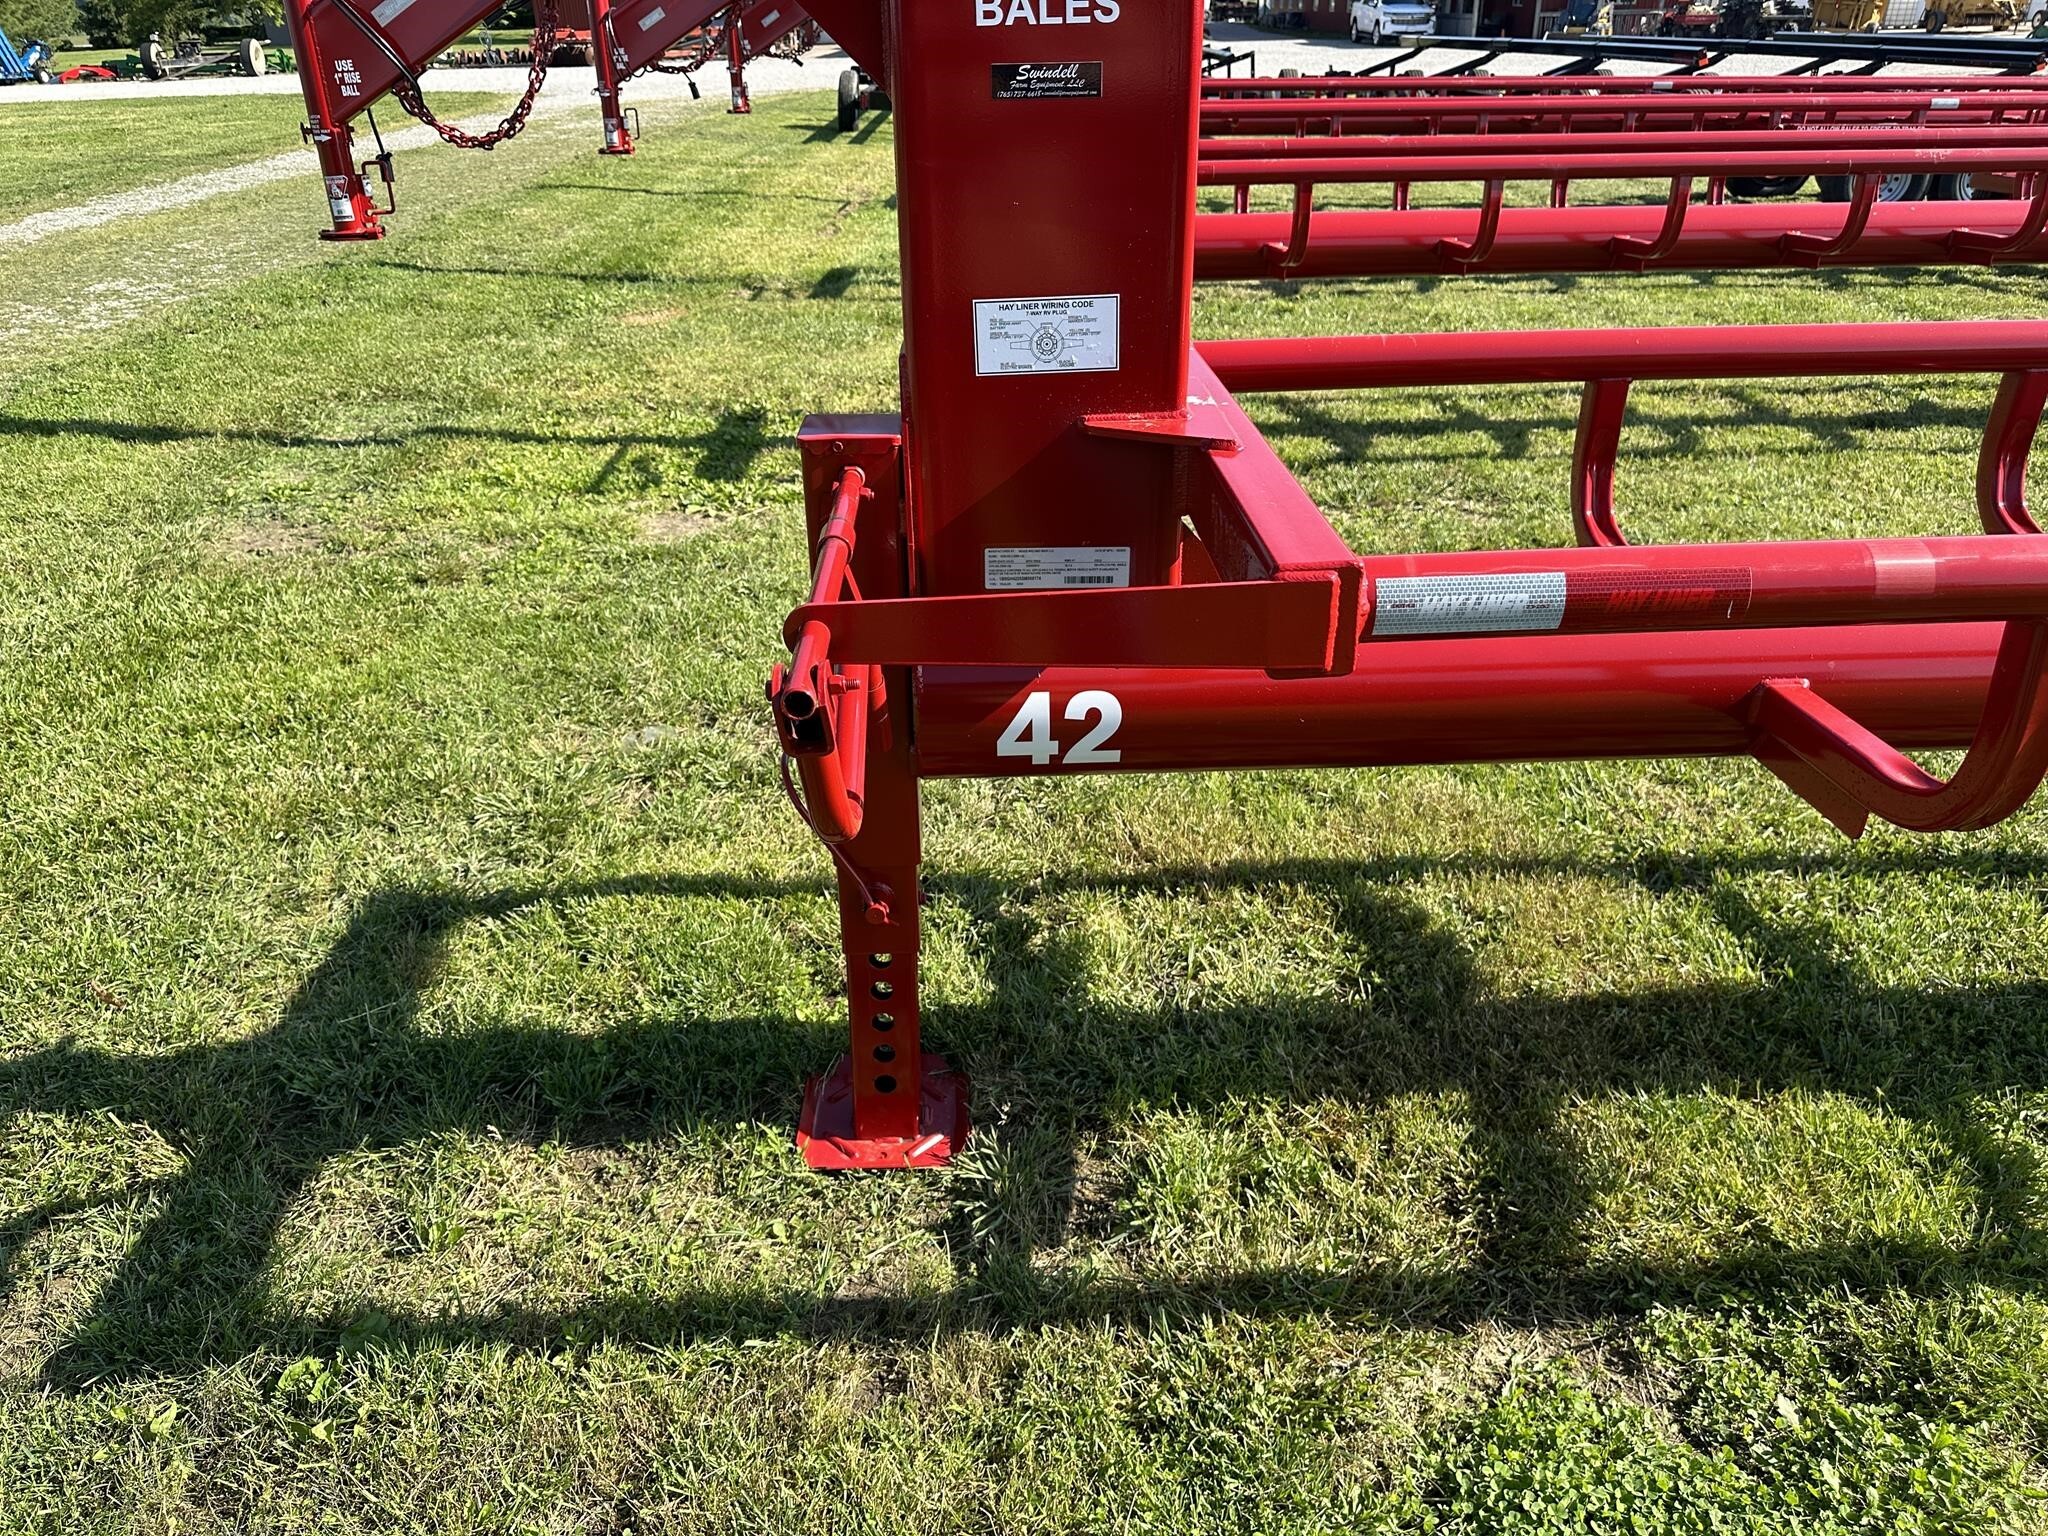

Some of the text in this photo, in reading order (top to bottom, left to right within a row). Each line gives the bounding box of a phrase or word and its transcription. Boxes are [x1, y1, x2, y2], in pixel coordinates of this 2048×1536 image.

[975, 0, 1120, 26] BALES
[335, 60, 354, 71] USE
[343, 72, 361, 83] RISE
[1016, 64, 1079, 80] Swindell
[1010, 81, 1028, 89] Farm
[1067, 79, 1085, 87] LLC
[341, 85, 360, 96] BALL
[998, 303, 1014, 311] HAY
[996, 690, 1123, 765] 42
